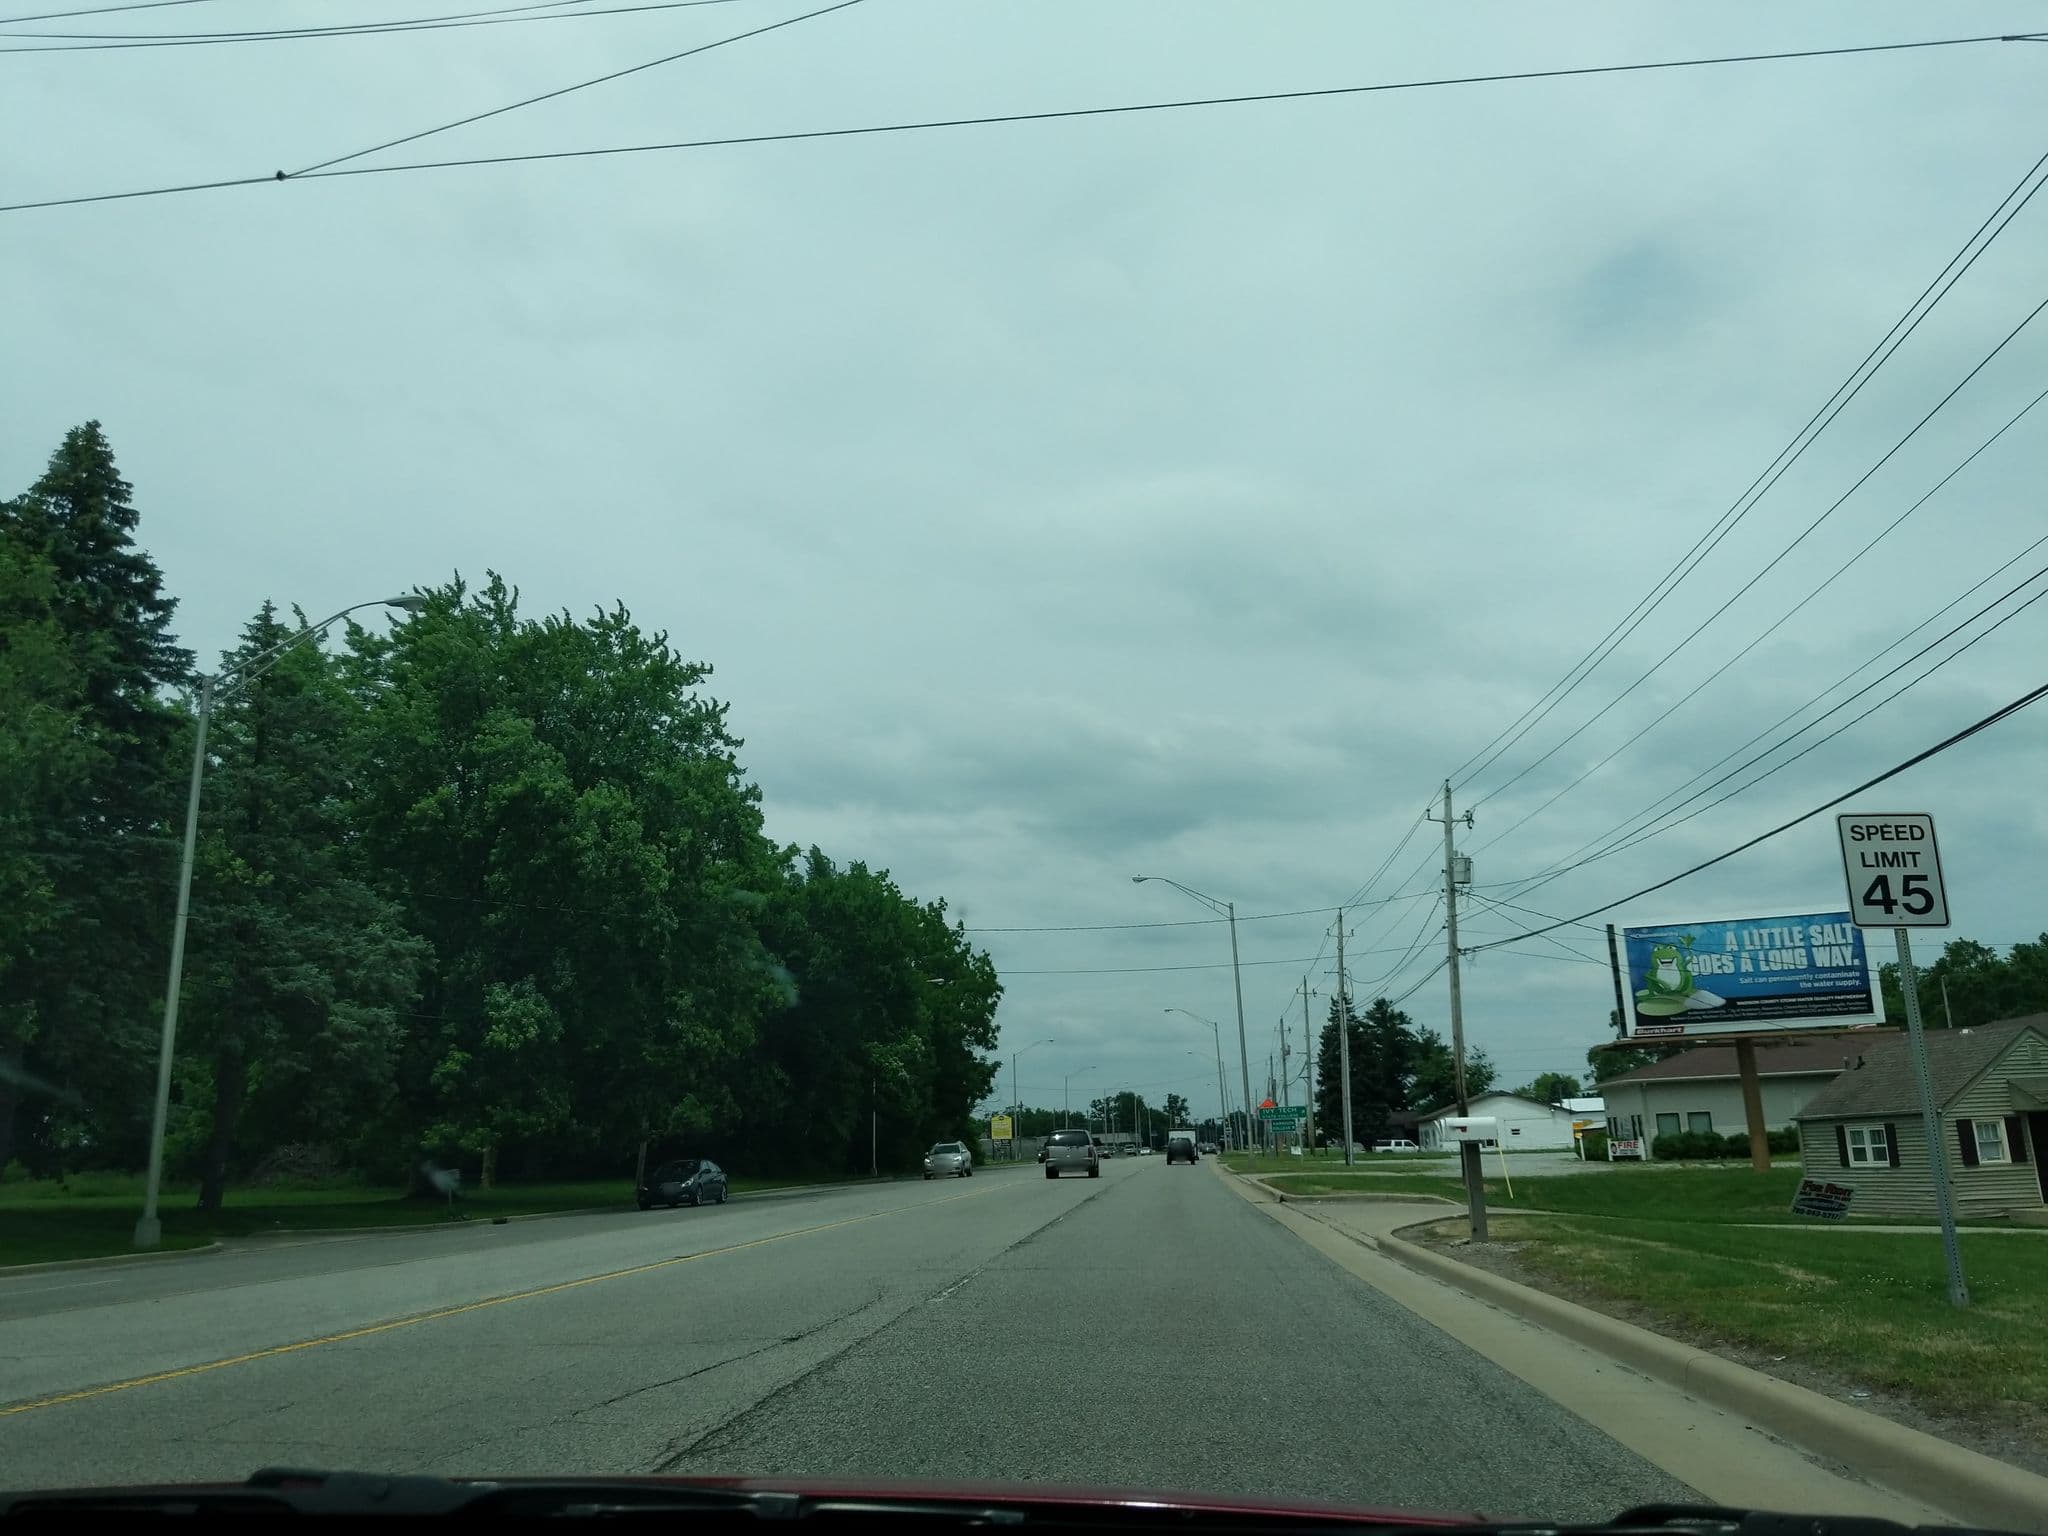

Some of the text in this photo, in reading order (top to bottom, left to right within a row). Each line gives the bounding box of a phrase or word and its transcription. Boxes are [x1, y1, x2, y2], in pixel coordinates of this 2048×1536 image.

[1850, 824, 1925, 842] SPEED
[1860, 851, 1921, 868] LIMIT
[1862, 874, 1935, 916] 45
[1726, 922, 1854, 952] A LITTLE SALT
[1688, 946, 1860, 977] GOES A LONG WAY.
[1739, 977, 1753, 985] Salt
[1768, 973, 1813, 983] permanently
[1815, 970, 1860, 979] contaminate
[1800, 978, 1862, 989] the water supply.
[1636, 1027, 1683, 1035] Burkhart
